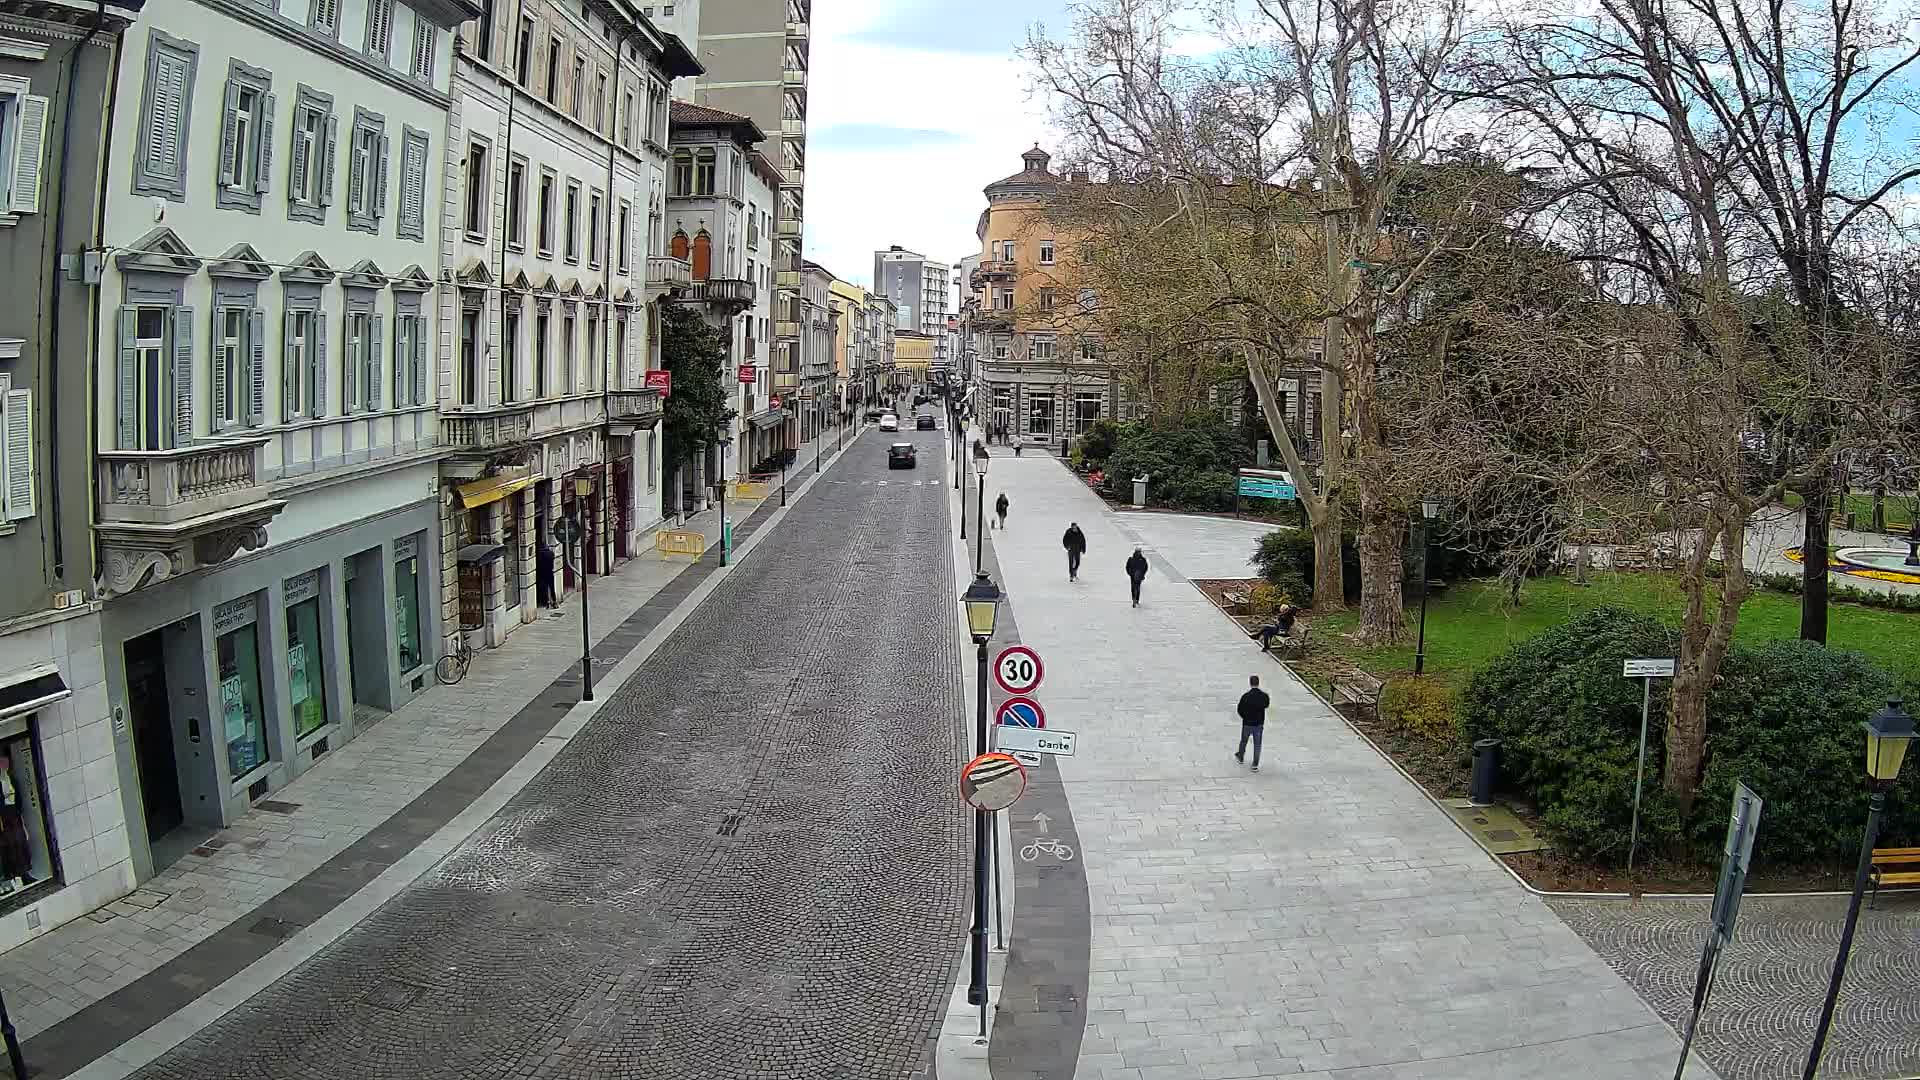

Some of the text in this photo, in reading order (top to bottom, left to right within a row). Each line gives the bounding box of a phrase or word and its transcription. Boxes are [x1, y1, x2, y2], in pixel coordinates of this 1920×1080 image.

[1005, 659, 1033, 682] 30
[222, 679, 240, 701] 130
[1038, 739, 1070, 751] Dante
